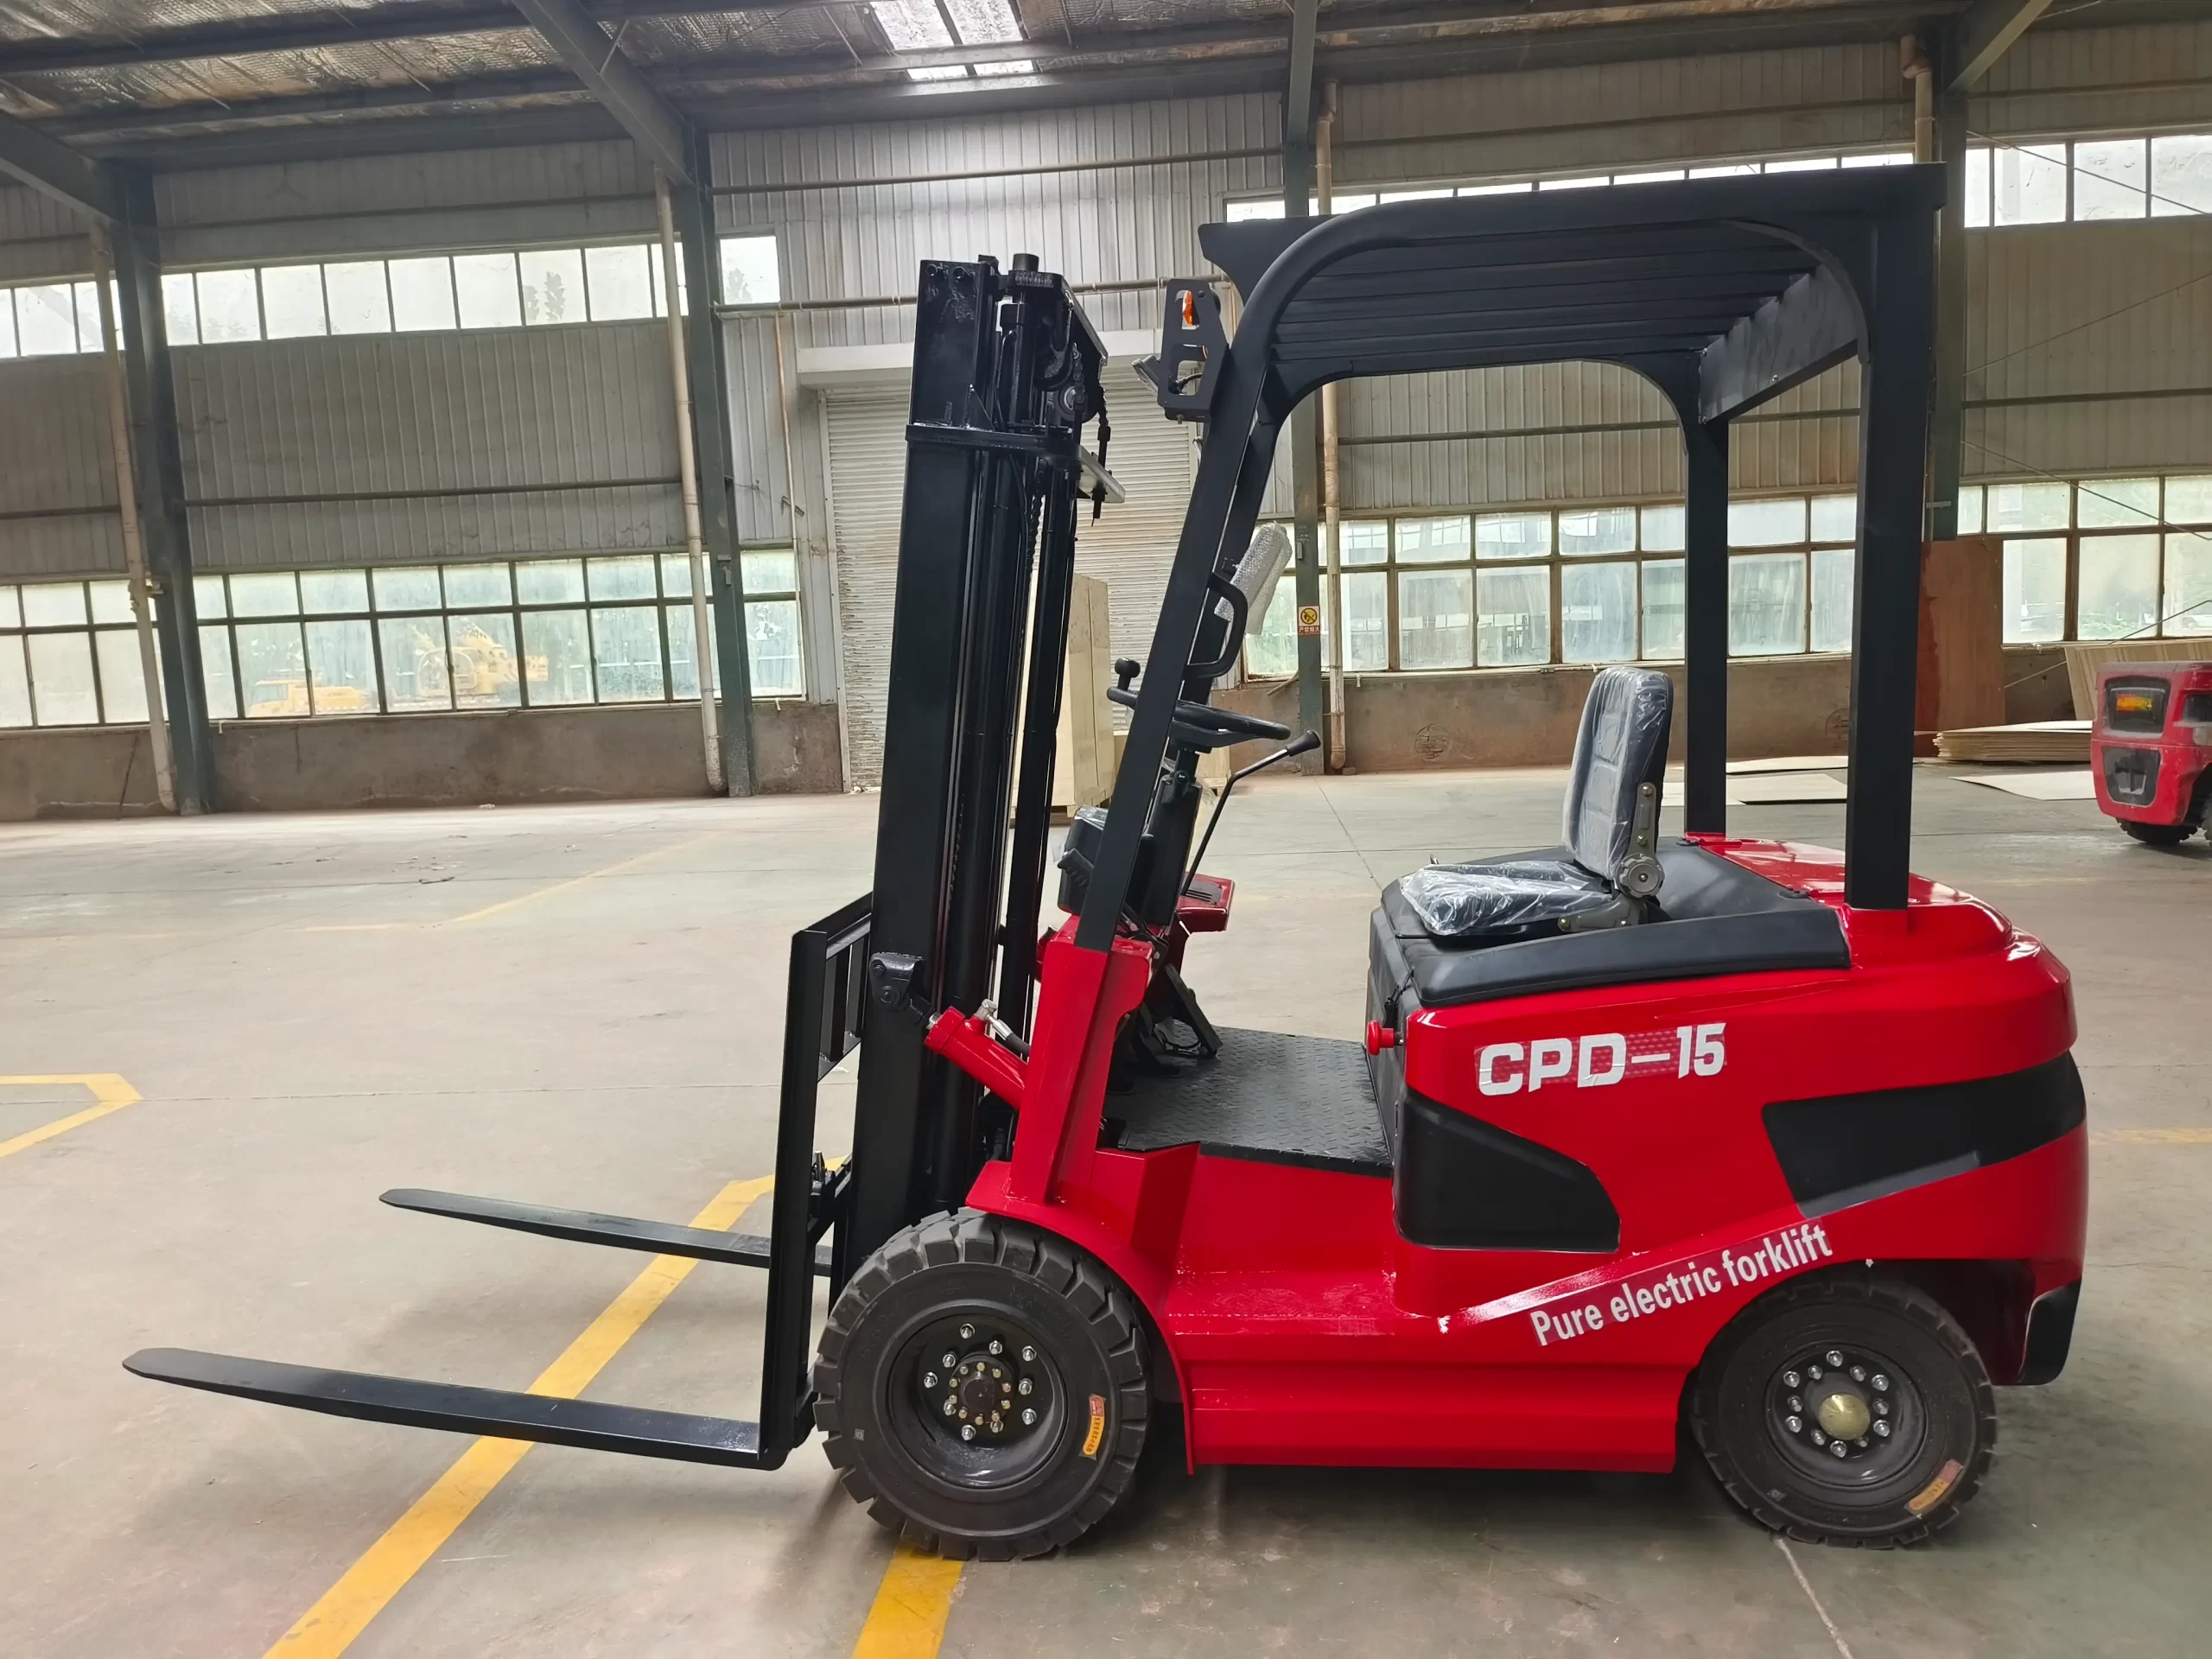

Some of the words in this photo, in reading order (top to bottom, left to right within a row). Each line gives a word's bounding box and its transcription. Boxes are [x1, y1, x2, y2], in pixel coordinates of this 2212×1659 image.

[1529, 1303, 1605, 1346] Pure
[1610, 1262, 1722, 1323] electric
[1722, 1224, 1833, 1287] forklift
